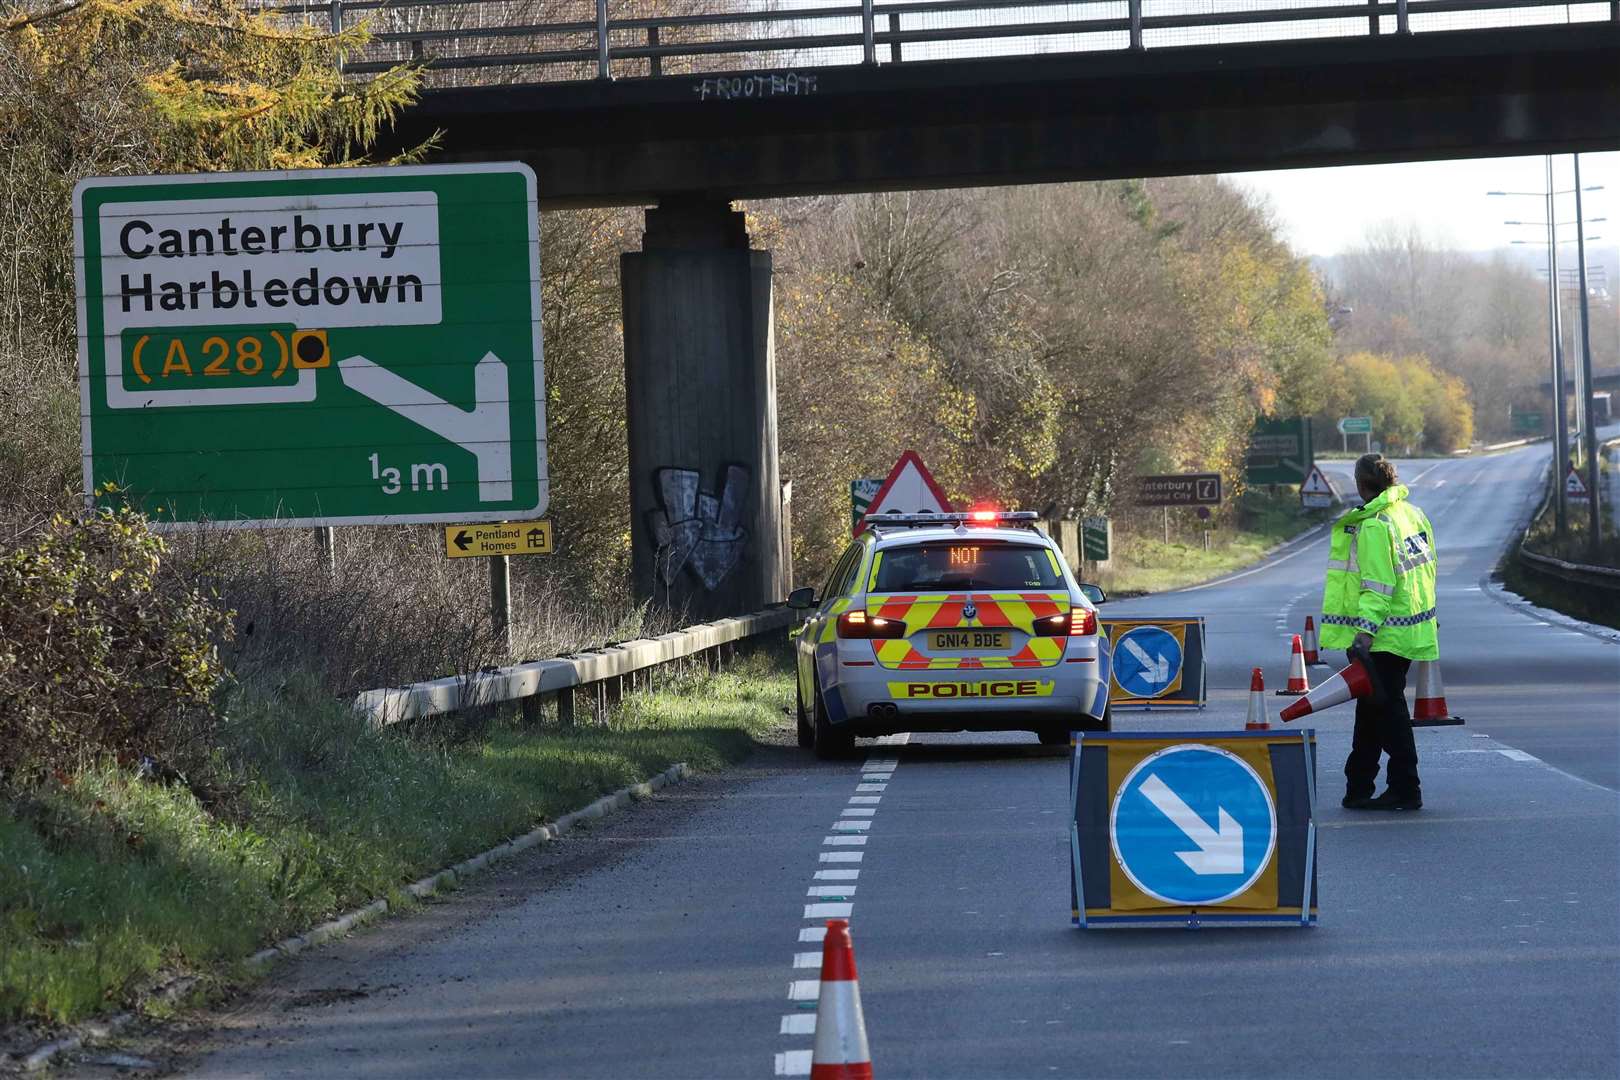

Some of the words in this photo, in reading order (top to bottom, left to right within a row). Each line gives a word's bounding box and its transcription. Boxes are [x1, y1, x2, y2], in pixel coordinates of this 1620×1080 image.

[119, 215, 404, 259] Canterbury
[120, 268, 423, 312] Harbledown
[411, 462, 448, 492] m
[476, 528, 521, 540] Pentland
[481, 541, 517, 552] Homes
[951, 547, 980, 564] NOT
[936, 633, 969, 648] GN14
[974, 633, 1003, 647] BDE
[908, 681, 1037, 697] POLICE
